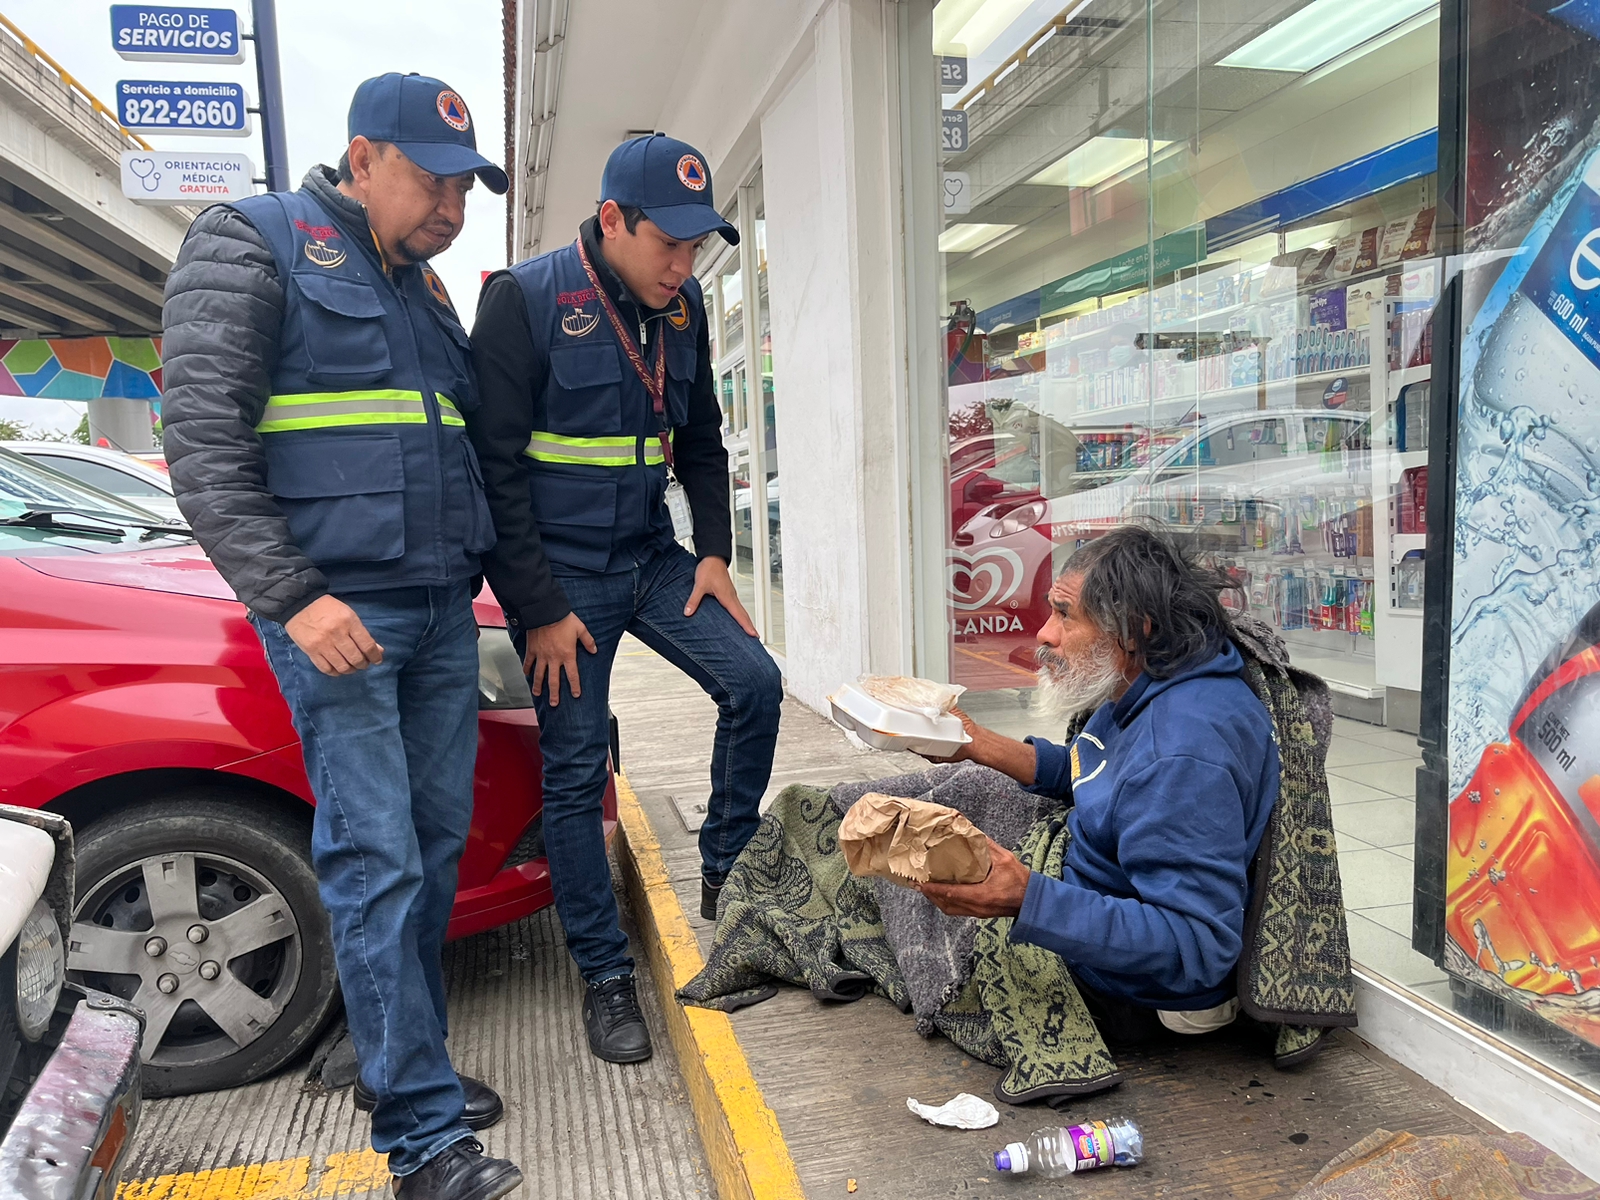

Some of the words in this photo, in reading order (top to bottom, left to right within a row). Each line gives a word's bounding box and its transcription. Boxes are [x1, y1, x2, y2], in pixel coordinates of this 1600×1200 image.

[139, 13, 184, 28] PAGO
[189, 14, 209, 28] DE
[118, 28, 233, 49] SERVICIOS
[122, 84, 171, 95] Servicio
[173, 87, 181, 95] a
[184, 85, 238, 97] domicilio
[125, 98, 237, 126] 822-2660
[165, 160, 241, 172] ORIENTACIÓN
[182, 172, 225, 184] MÉDICA
[179, 184, 230, 194] GRATUITA
[1552, 294, 1575, 320] 600
[1569, 313, 1589, 334] ml
[1538, 720, 1562, 753] 500
[1556, 748, 1576, 772] ml
